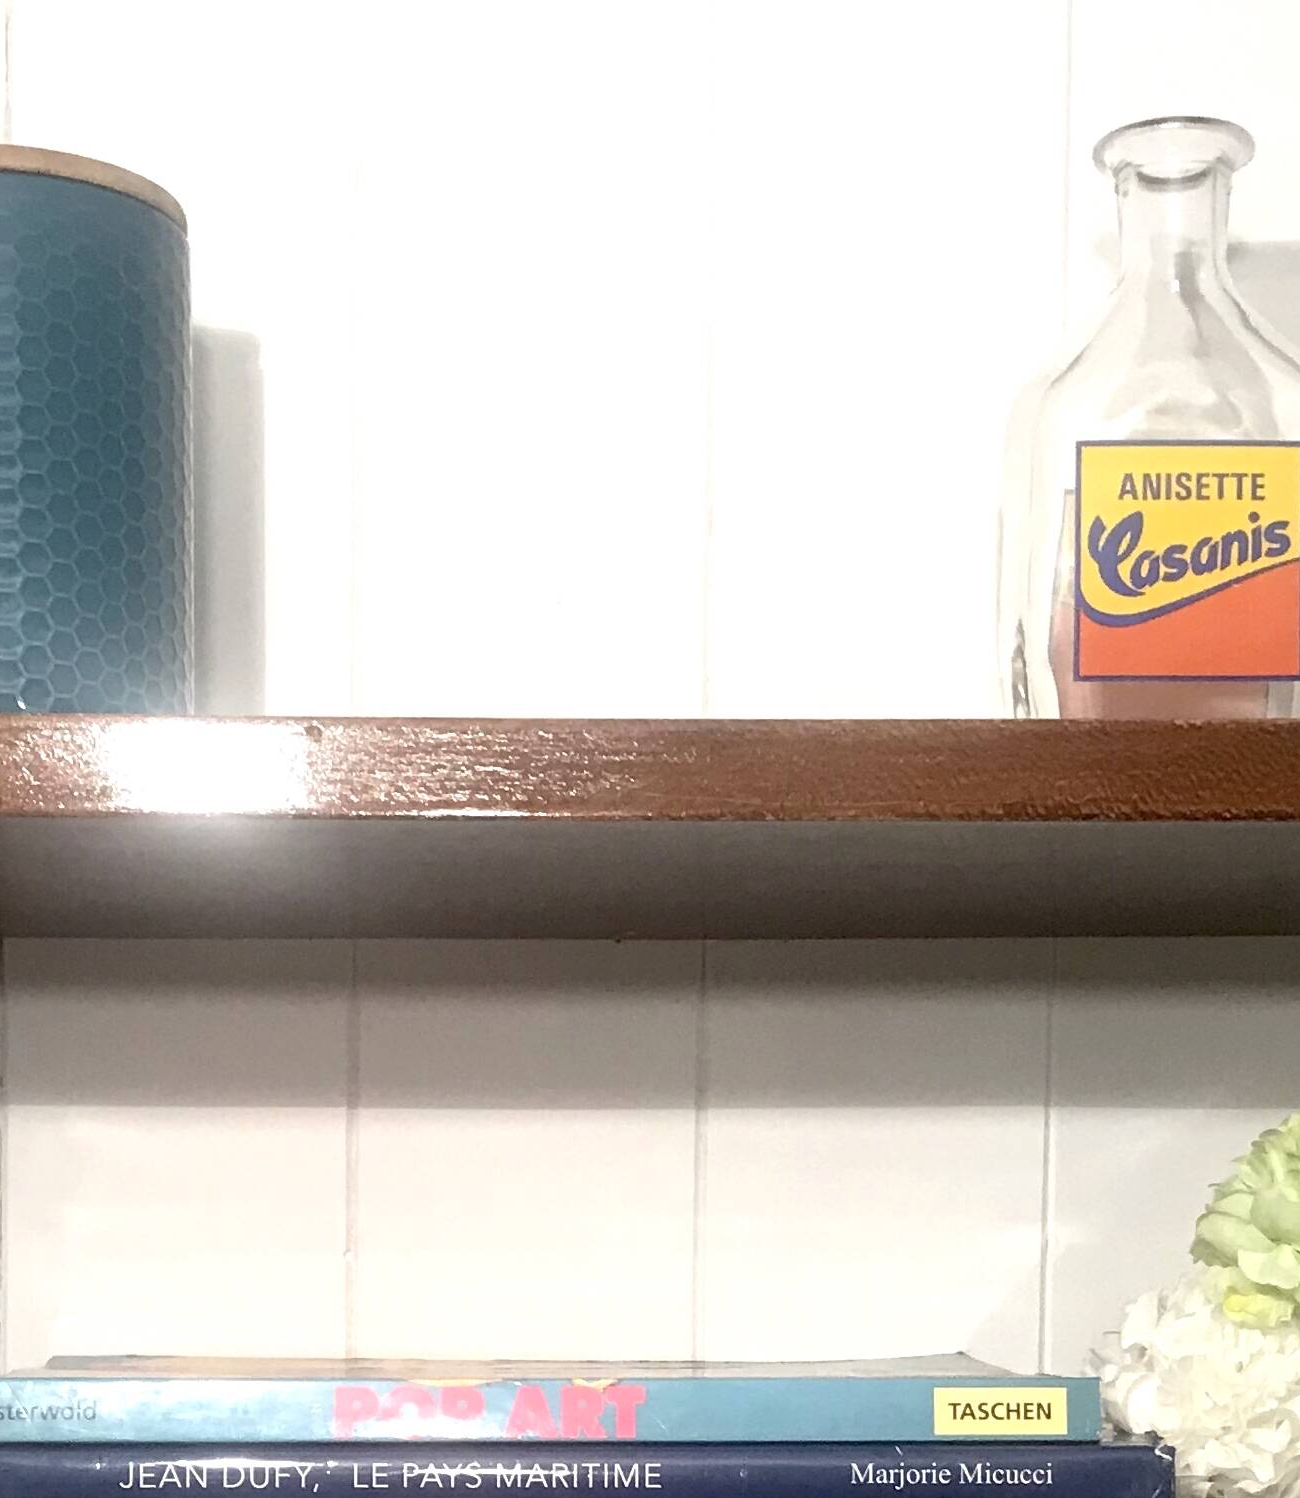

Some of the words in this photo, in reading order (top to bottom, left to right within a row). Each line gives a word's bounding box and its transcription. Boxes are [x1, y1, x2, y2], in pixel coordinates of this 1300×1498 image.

[1118, 472, 1266, 500] ANISETTE
[1087, 510, 1292, 597] Casanis
[504, 1385, 646, 1439] ART
[948, 1402, 1052, 1421] TASCHEN
[119, 1463, 207, 1489] JEAN
[352, 1462, 389, 1488] LE
[402, 1462, 482, 1488] PAYS
[496, 1462, 662, 1488] MARITIME
[851, 1462, 952, 1490] Marjorie
[959, 1462, 1053, 1485] Micucci
